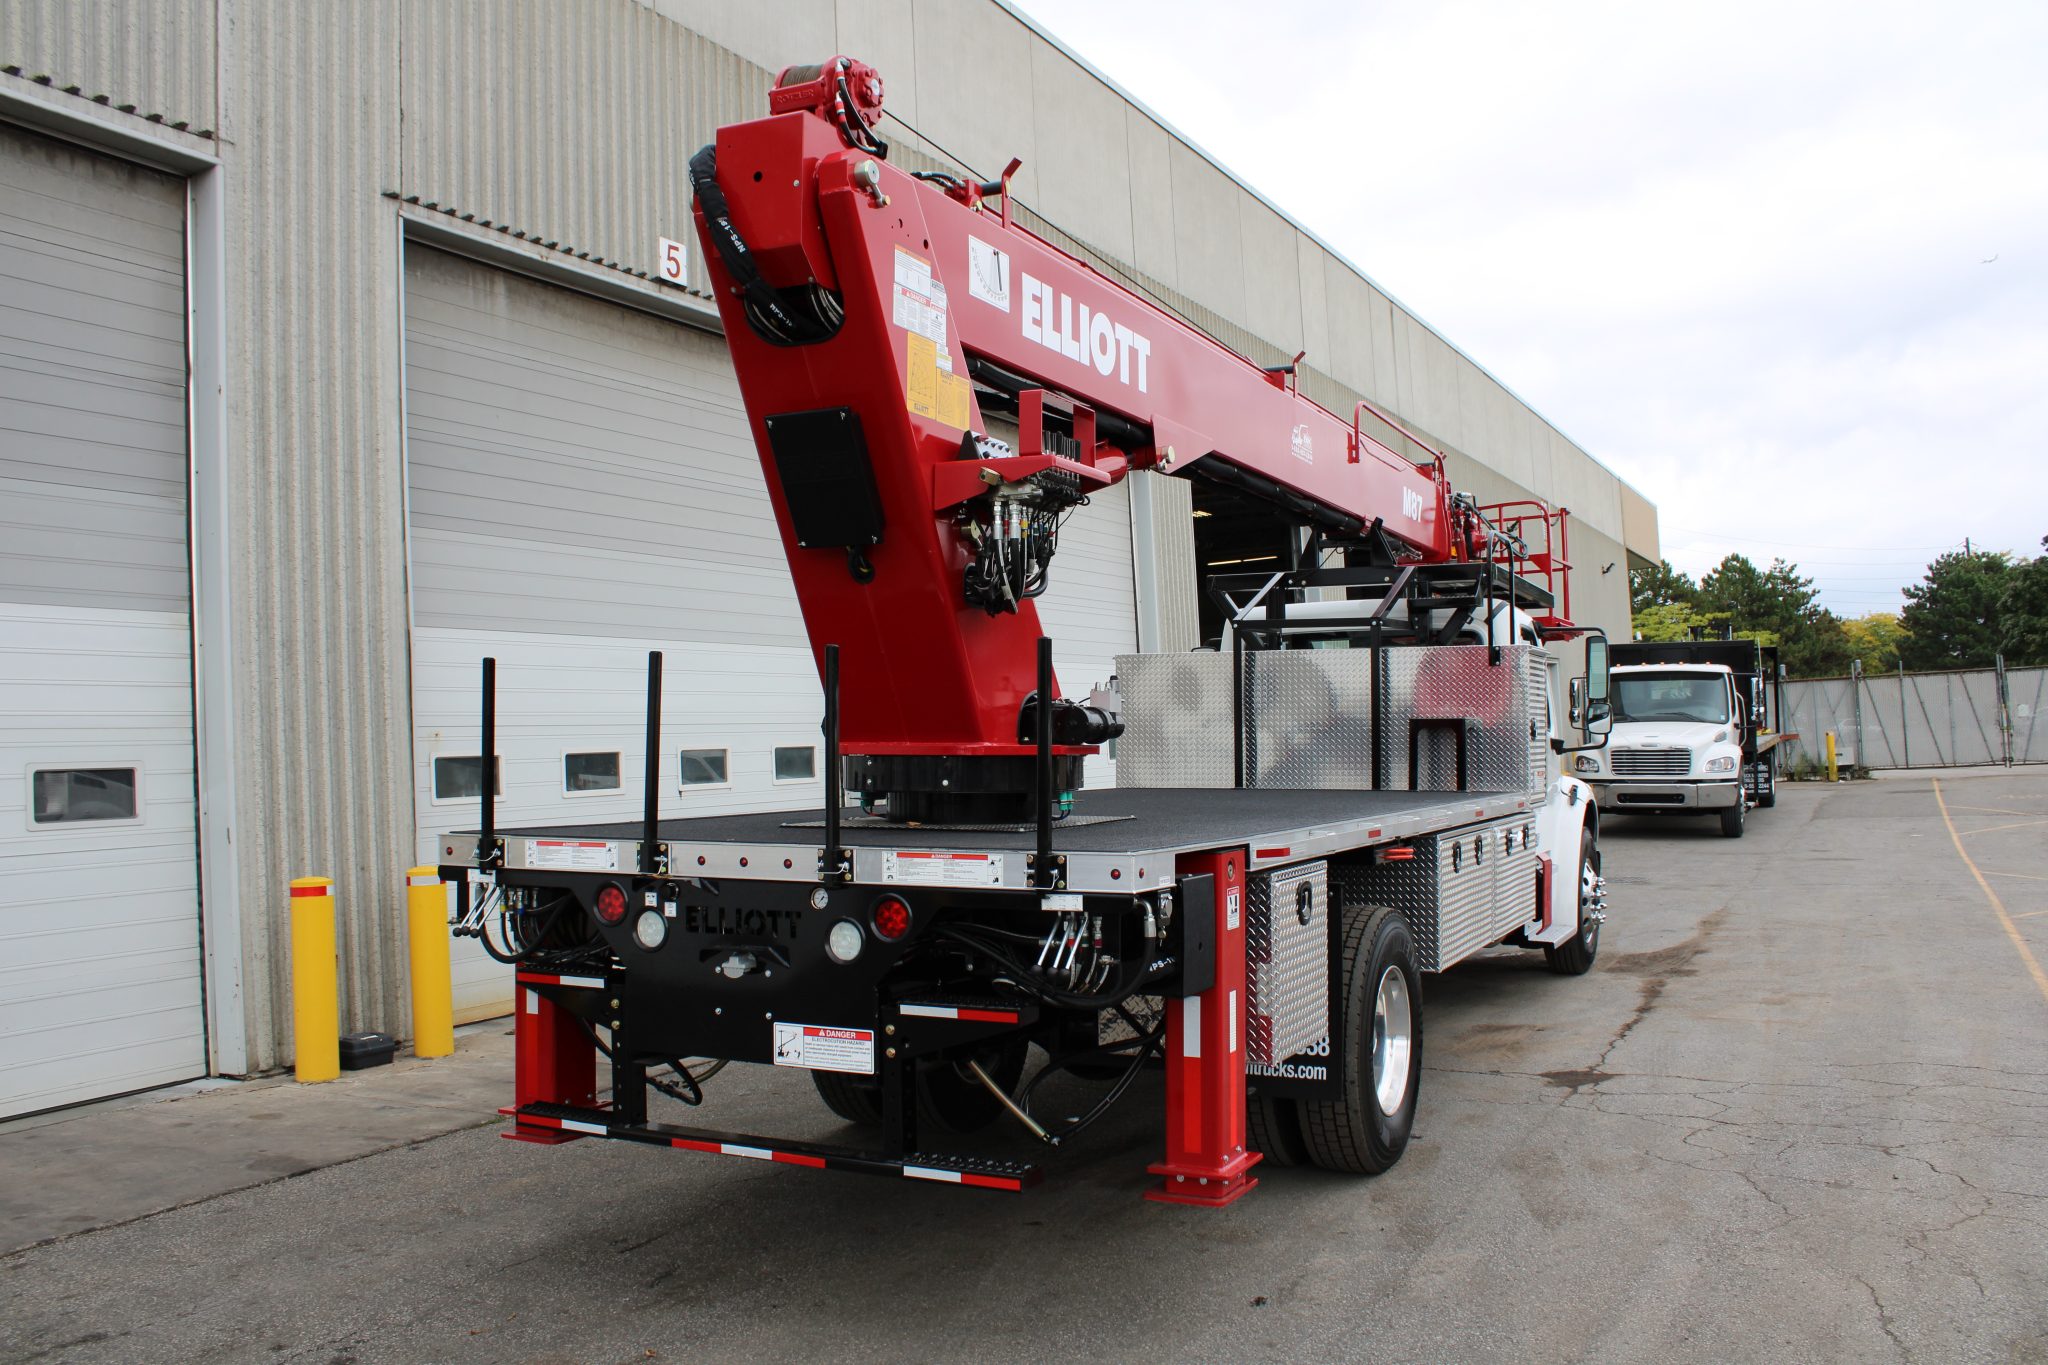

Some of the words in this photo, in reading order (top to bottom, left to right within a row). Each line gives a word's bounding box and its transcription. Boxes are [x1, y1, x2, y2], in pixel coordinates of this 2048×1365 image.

[666, 243, 681, 279] 5
[1021, 271, 1151, 394] ELLIOTT
[1402, 485, 1423, 524] M87
[685, 905, 801, 938] ELLIOTT
[826, 1029, 856, 1039] DANGER
